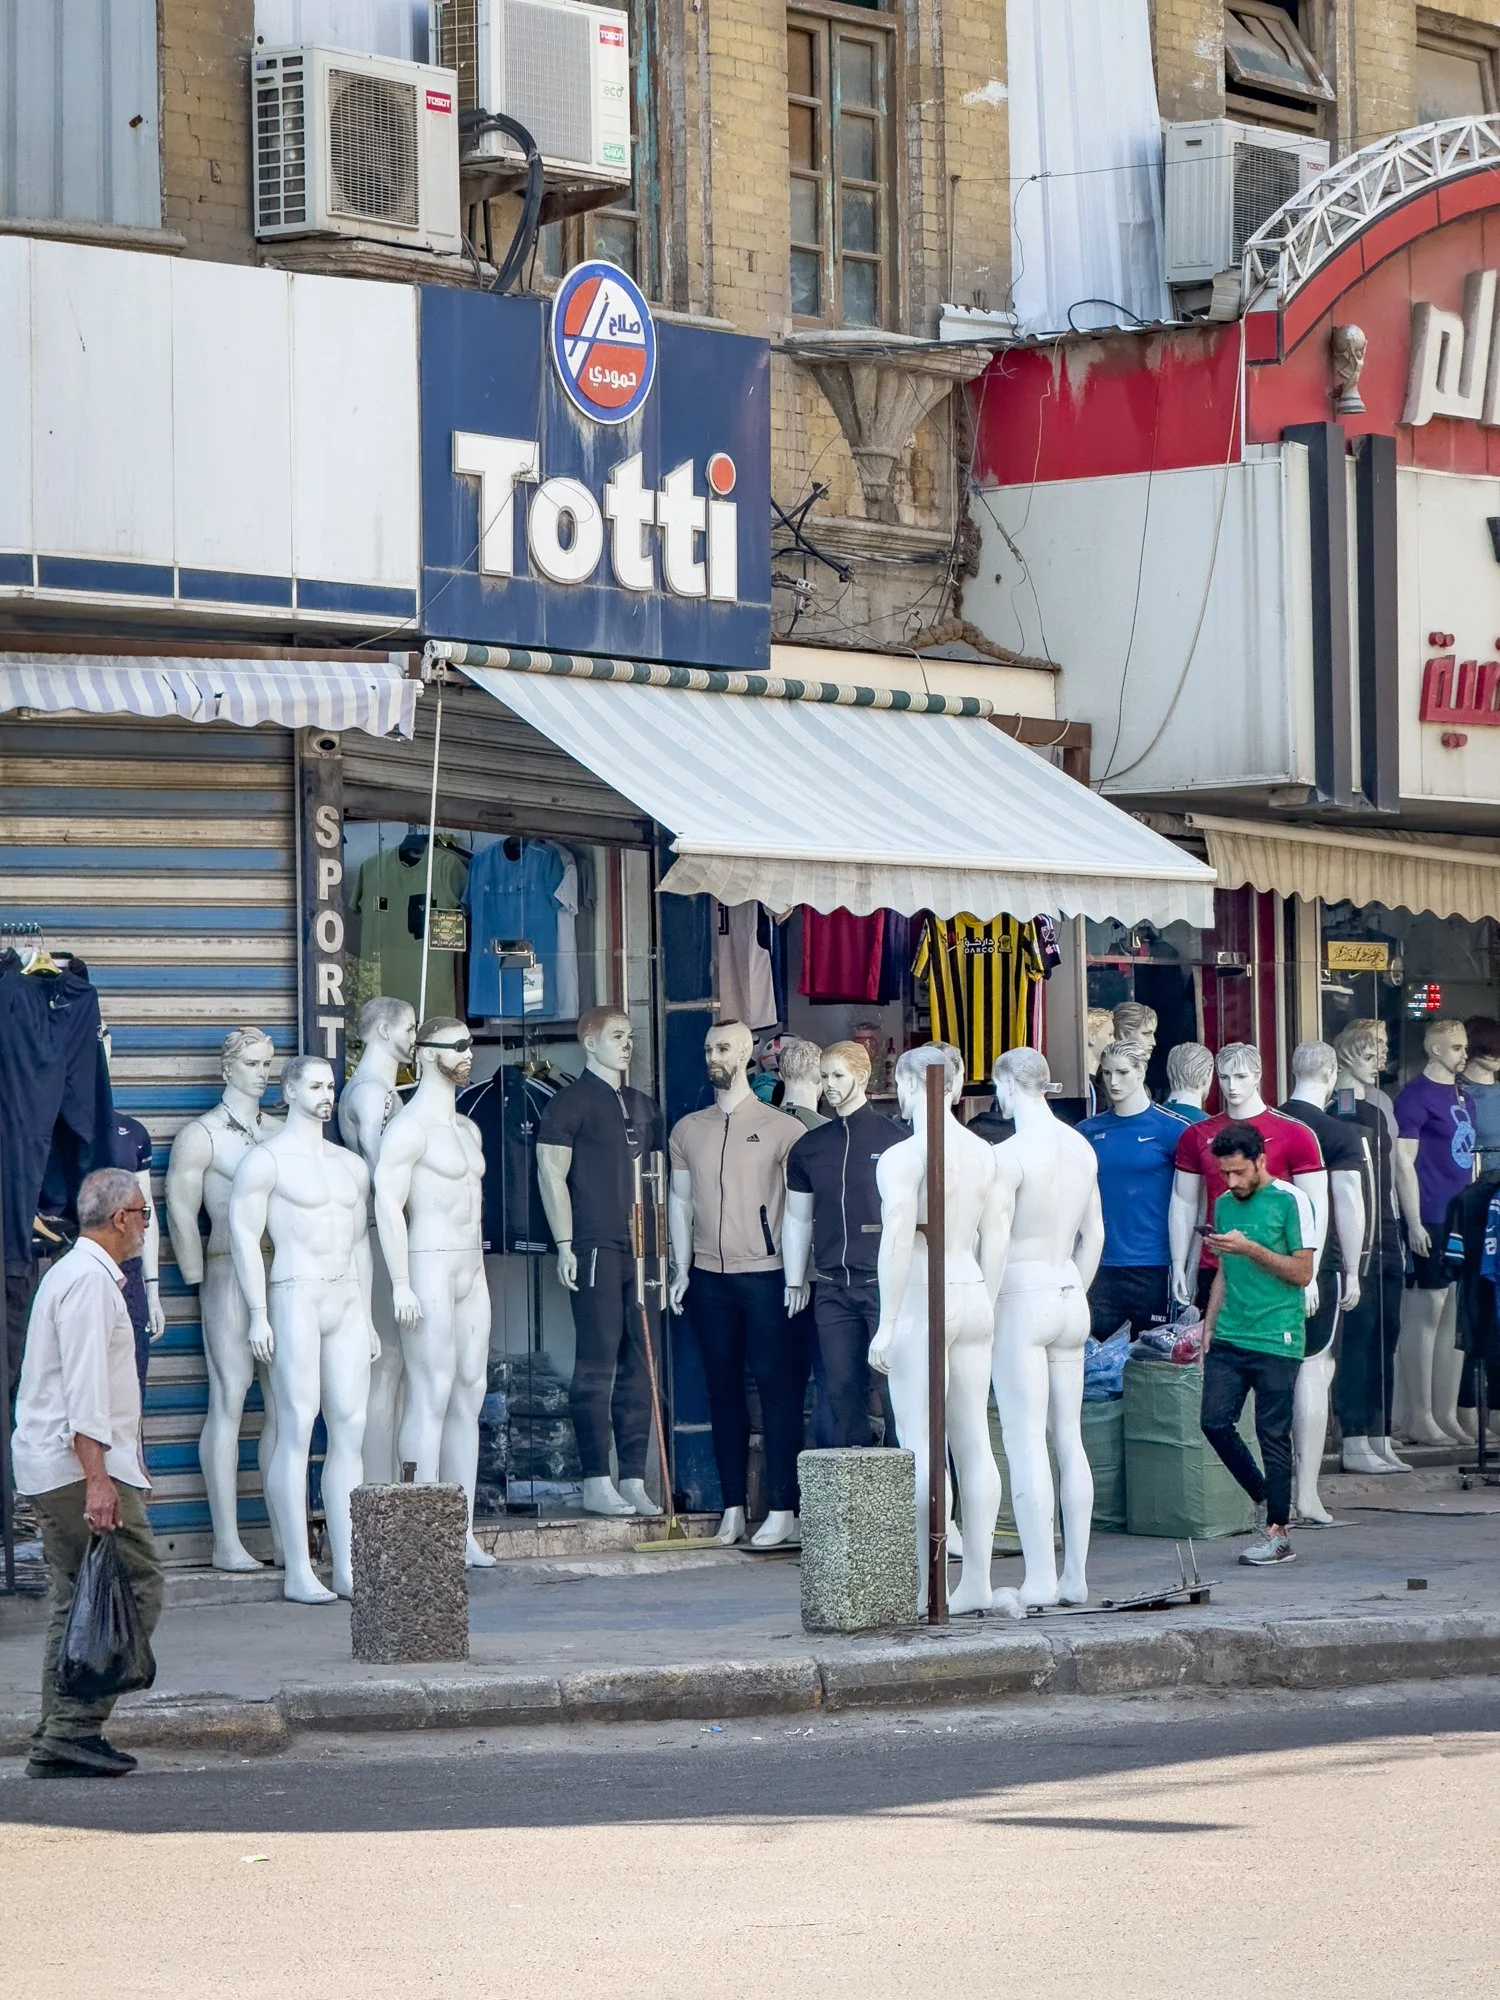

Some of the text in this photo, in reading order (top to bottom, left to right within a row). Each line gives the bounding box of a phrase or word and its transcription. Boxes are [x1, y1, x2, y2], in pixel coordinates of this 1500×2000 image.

[600, 30, 624, 42] TOSOT
[604, 86, 623, 98] eco
[426, 96, 451, 108] TOSOT
[1306, 161, 1325, 171] TOSOT
[609, 314, 641, 336] صلاح
[588, 365, 637, 389] حمودي
[452, 431, 738, 602] Totti
[315, 805, 345, 1059] SPORT
[964, 946, 995, 954] DARCO
[1151, 1314, 1166, 1322] NIKE
